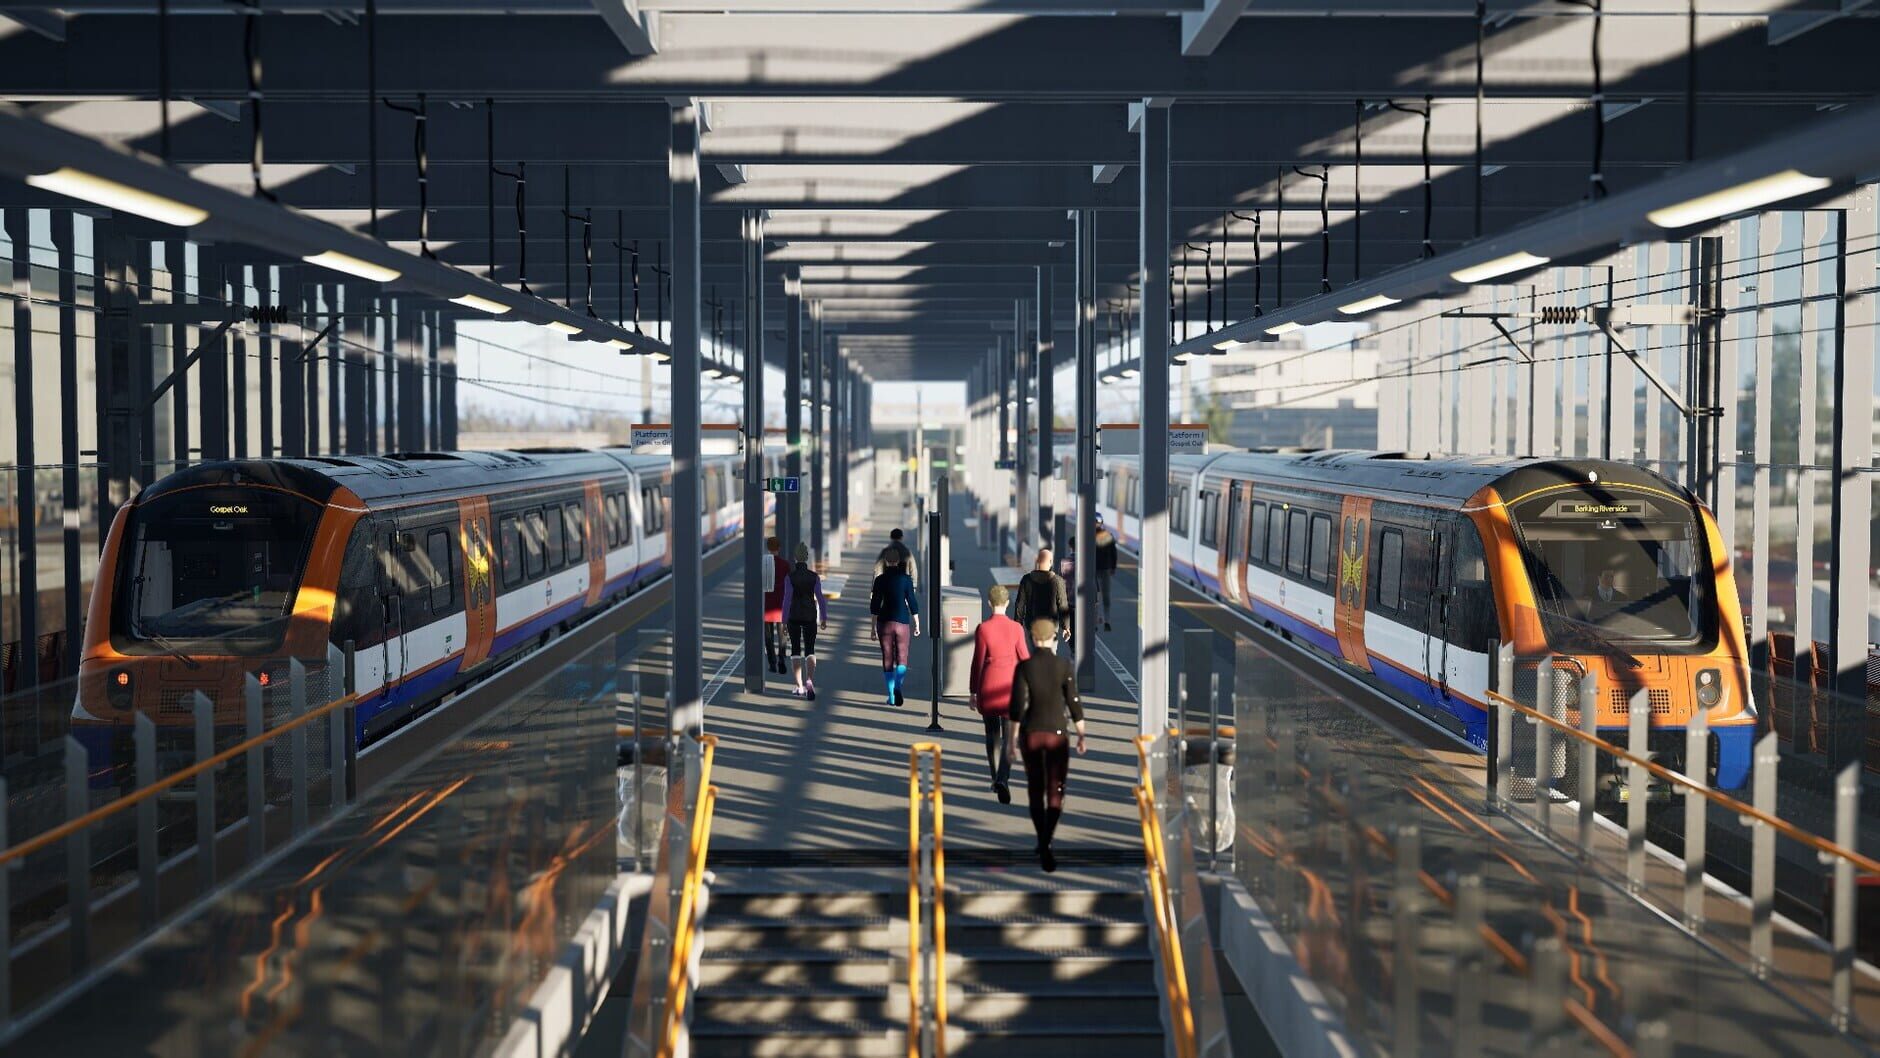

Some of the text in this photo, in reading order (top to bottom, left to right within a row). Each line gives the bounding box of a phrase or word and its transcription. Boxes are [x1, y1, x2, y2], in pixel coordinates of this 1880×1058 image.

[635, 430, 668, 438] Platform
[210, 505, 248, 513] Gospel Oak
[1574, 504, 1628, 513] Barking Riverside
